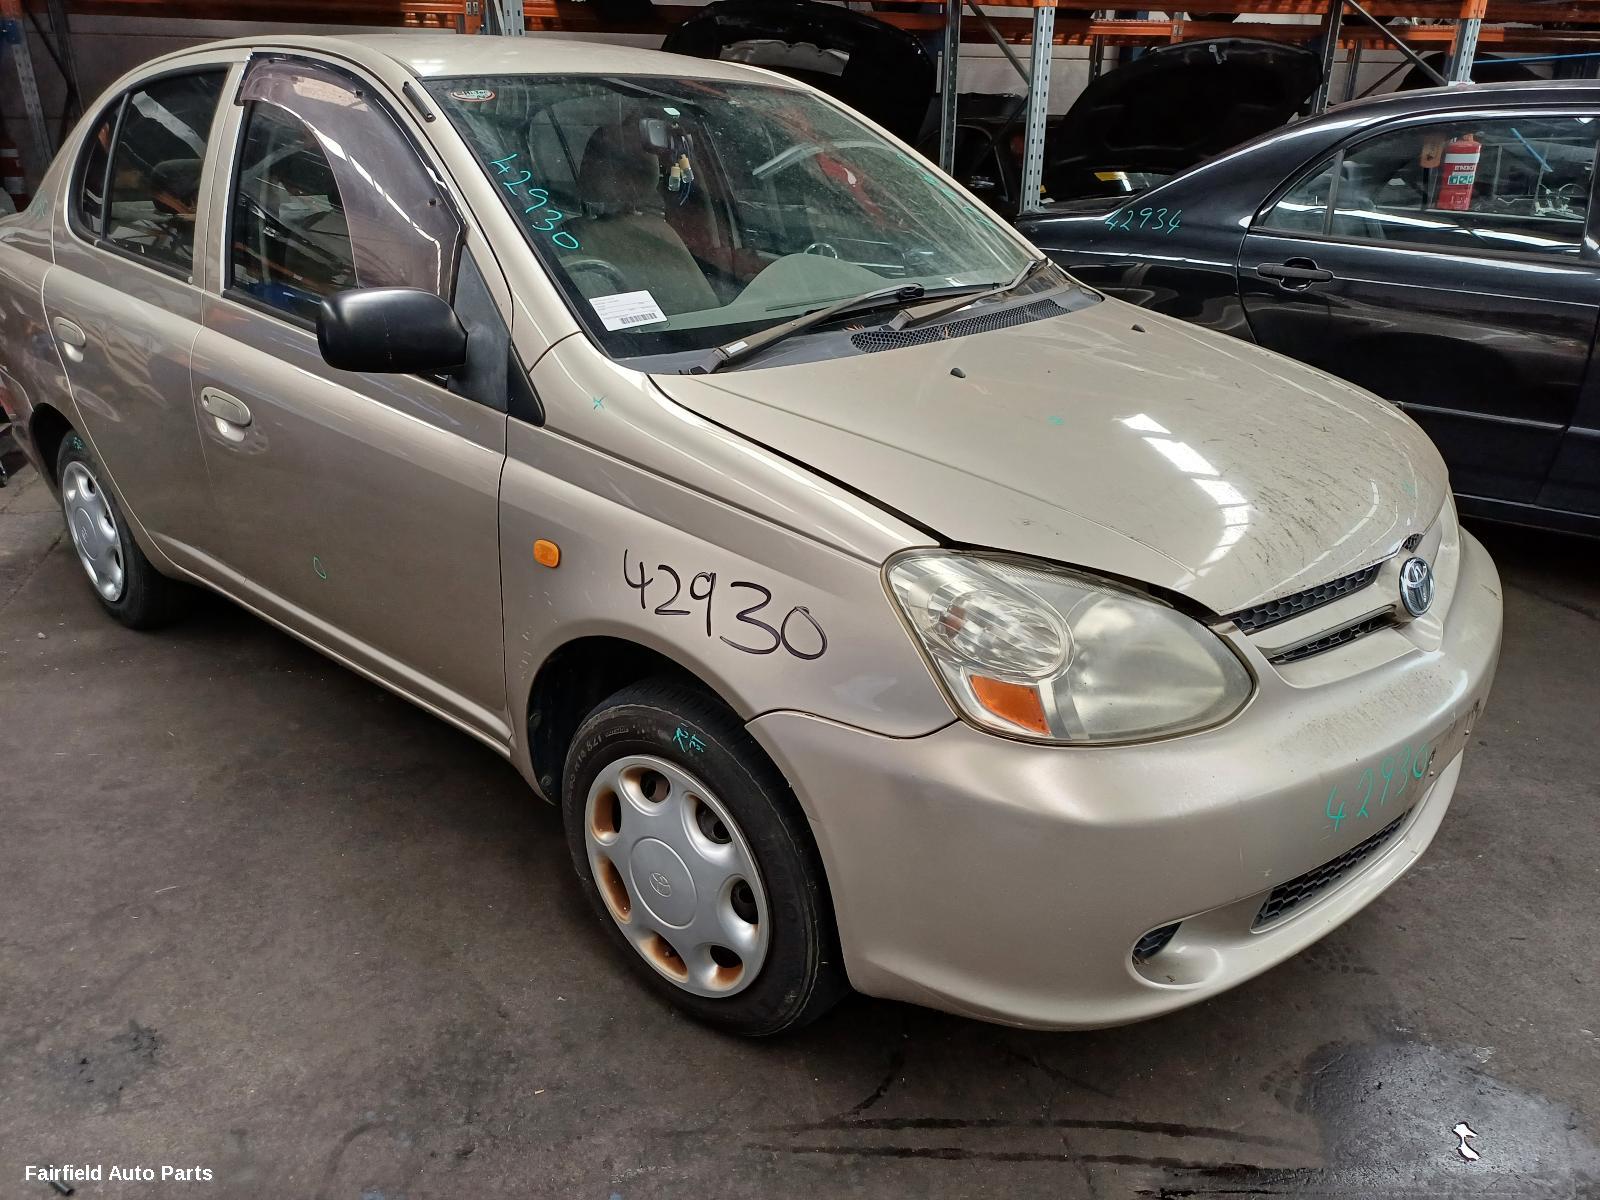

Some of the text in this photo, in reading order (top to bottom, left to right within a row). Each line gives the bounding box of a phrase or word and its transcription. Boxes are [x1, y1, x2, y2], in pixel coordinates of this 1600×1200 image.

[489, 153, 579, 249] 42930
[1105, 207, 1181, 234] 42934
[624, 549, 828, 660] 42930
[1325, 744, 1429, 832] 42930
